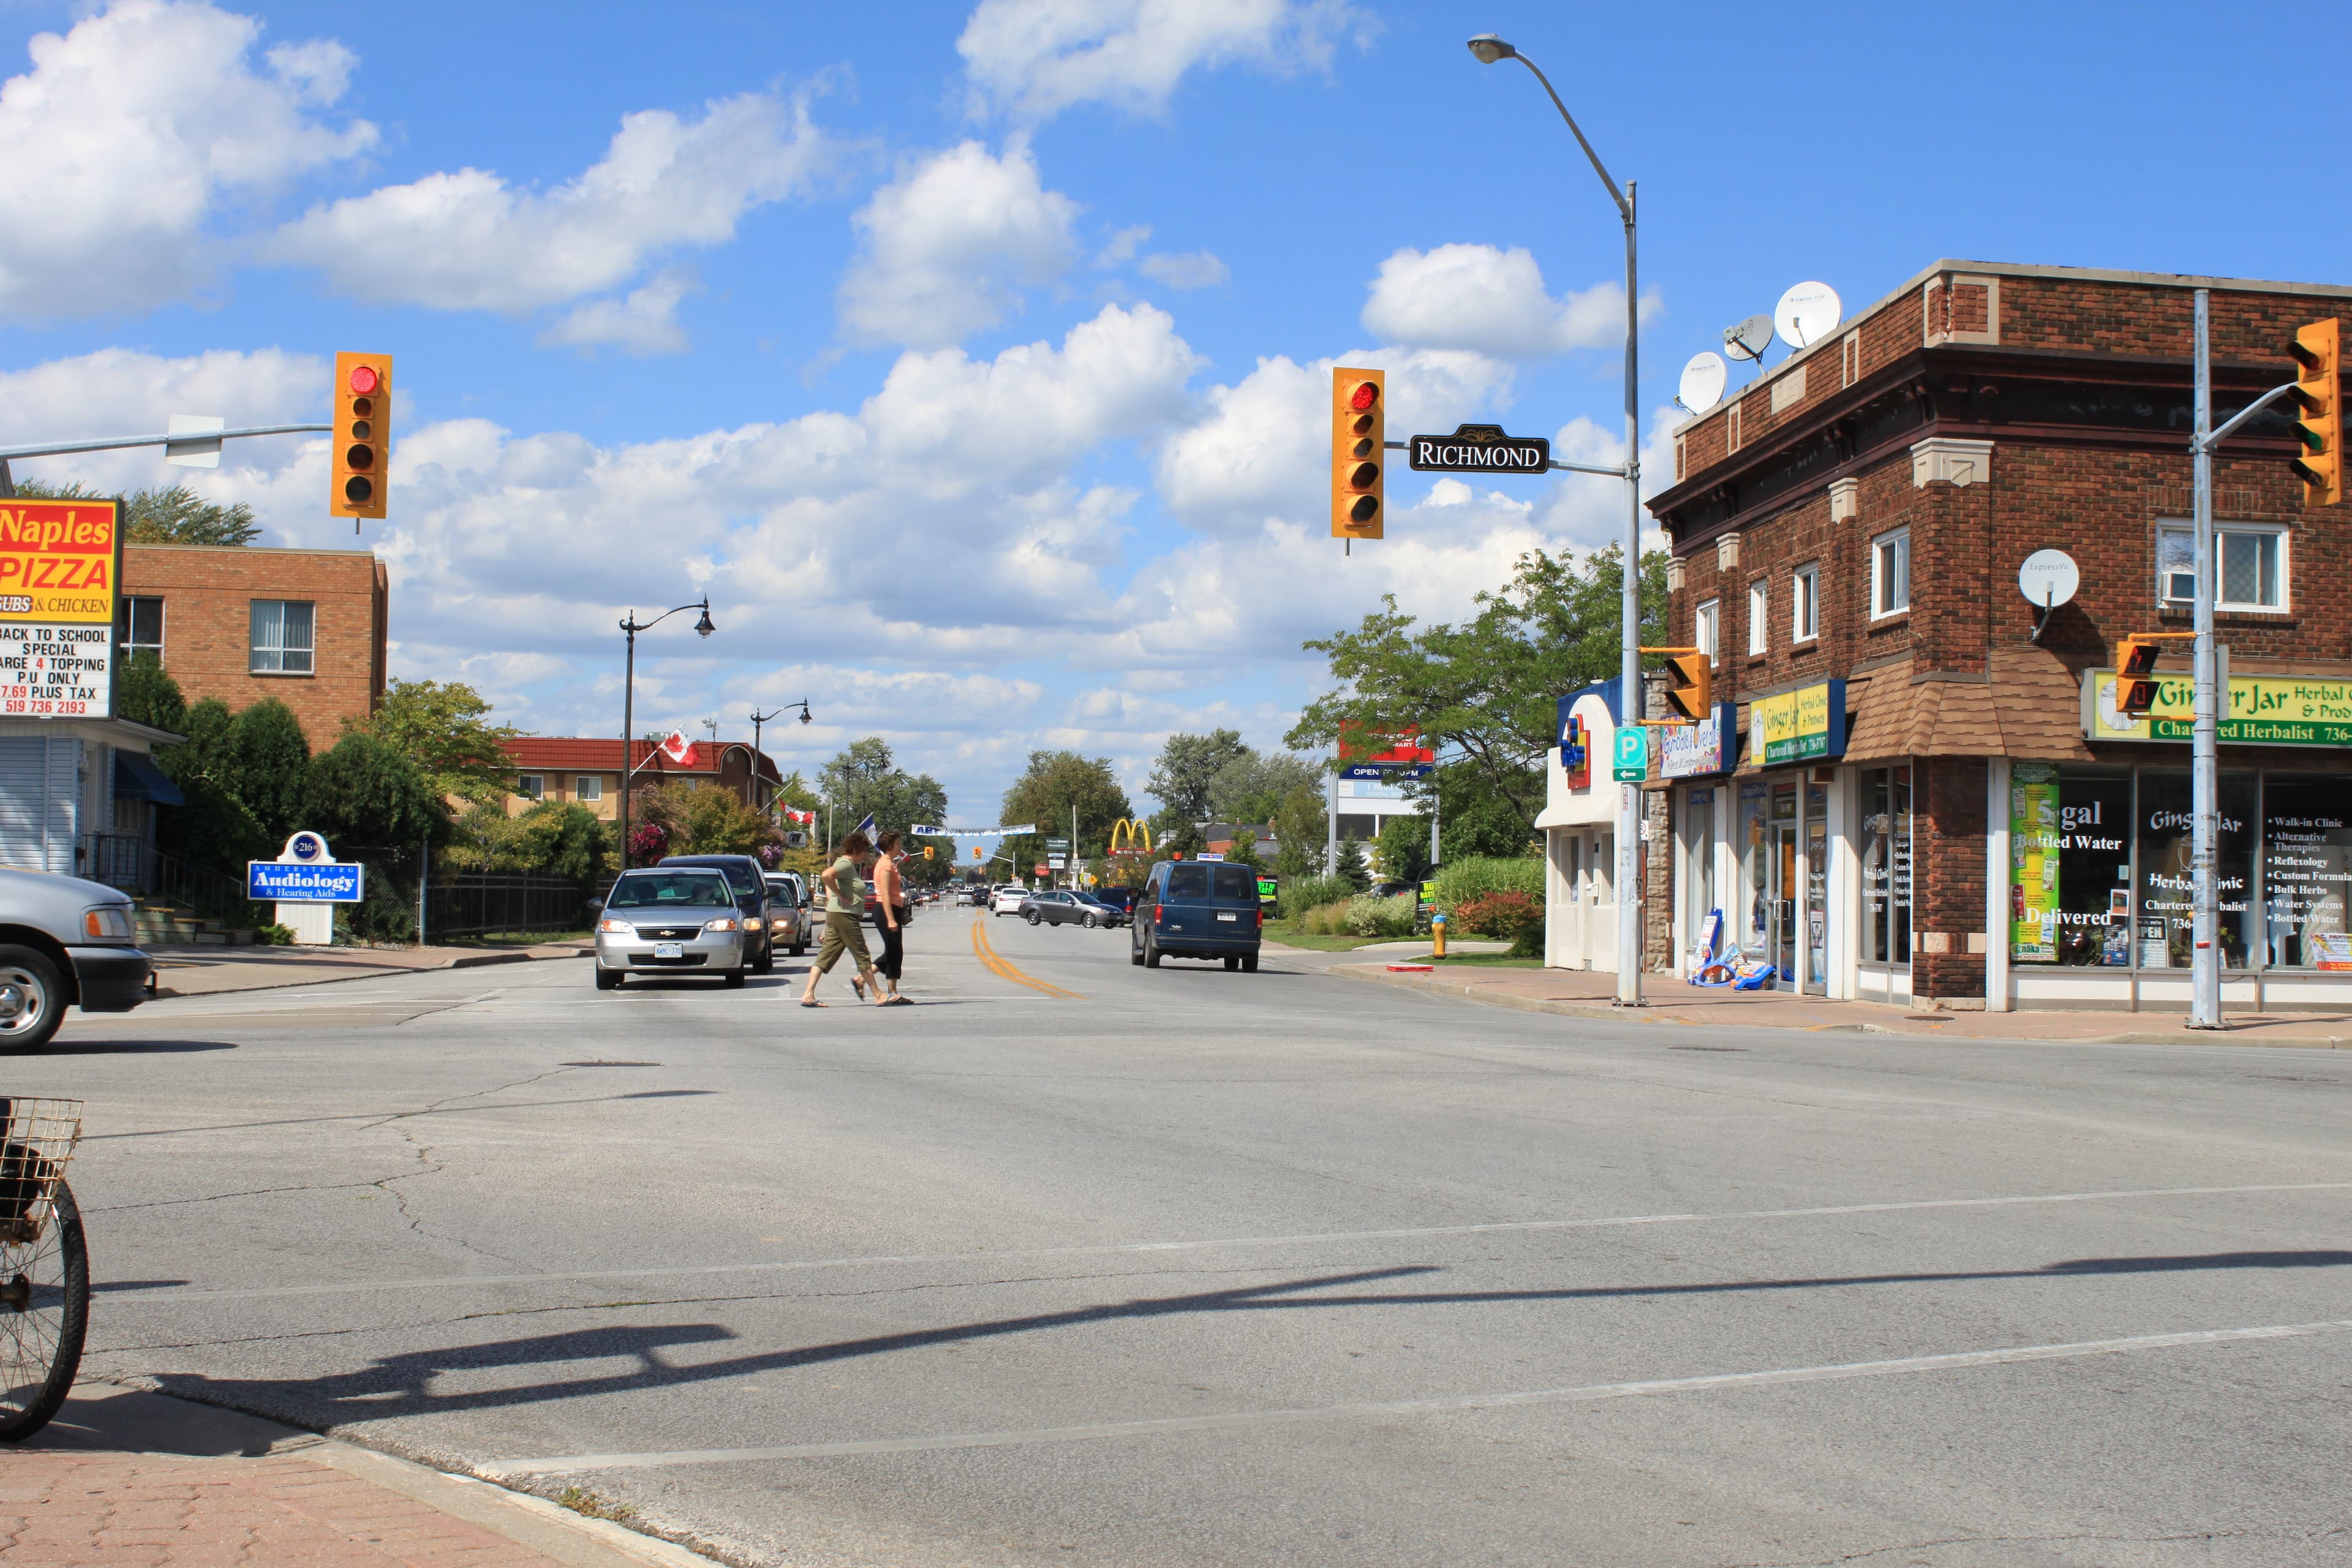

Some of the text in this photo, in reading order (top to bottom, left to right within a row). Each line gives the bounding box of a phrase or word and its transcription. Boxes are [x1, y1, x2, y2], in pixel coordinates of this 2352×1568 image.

[1417, 442, 1539, 467] RICHMOND
[0, 509, 110, 550] Naples
[0, 557, 107, 589] PIZZA
[35, 598, 45, 611] &
[48, 598, 109, 612] CHICKEN
[0, 628, 105, 642] ACK TO SCHOOL
[23, 643, 76, 655] SPECIAL
[36, 658, 43, 669] 4
[50, 658, 105, 671] TOPPING
[48, 673, 80, 684] ONLY
[32, 687, 62, 698] PLUS
[70, 687, 96, 699] TAX
[2247, 684, 2288, 715] Jar
[2294, 685, 2343, 700] Herbal
[6, 700, 85, 714] 519 736 2193
[1801, 696, 1814, 710] Herbal
[2302, 704, 2315, 717] &
[1767, 703, 1799, 735] Ginger Jar
[1694, 725, 1719, 749] Overalls
[2243, 723, 2314, 739] Herbalist
[1622, 736, 1638, 760] P
[2061, 801, 2102, 831] gal
[2274, 817, 2343, 827] Walk-in Clinic
[2018, 834, 2122, 850] Bottled Water
[2274, 832, 2327, 842] Alternative
[298, 842, 313, 852] 216
[2274, 842, 2320, 854] Therapies
[2274, 856, 2328, 869] Reflexology
[254, 872, 356, 892] Audiology
[2149, 873, 2243, 890] Herba inic
[2274, 870, 2310, 880] Custom
[277, 888, 313, 899] Hearing
[315, 889, 336, 897] Aids
[2274, 884, 2328, 894] Bulk Herbs
[2219, 902, 2247, 911] balist
[2274, 899, 2343, 911] Water Systems
[2026, 908, 2112, 925] Delivered
[2274, 913, 2340, 923] Bottled Water
